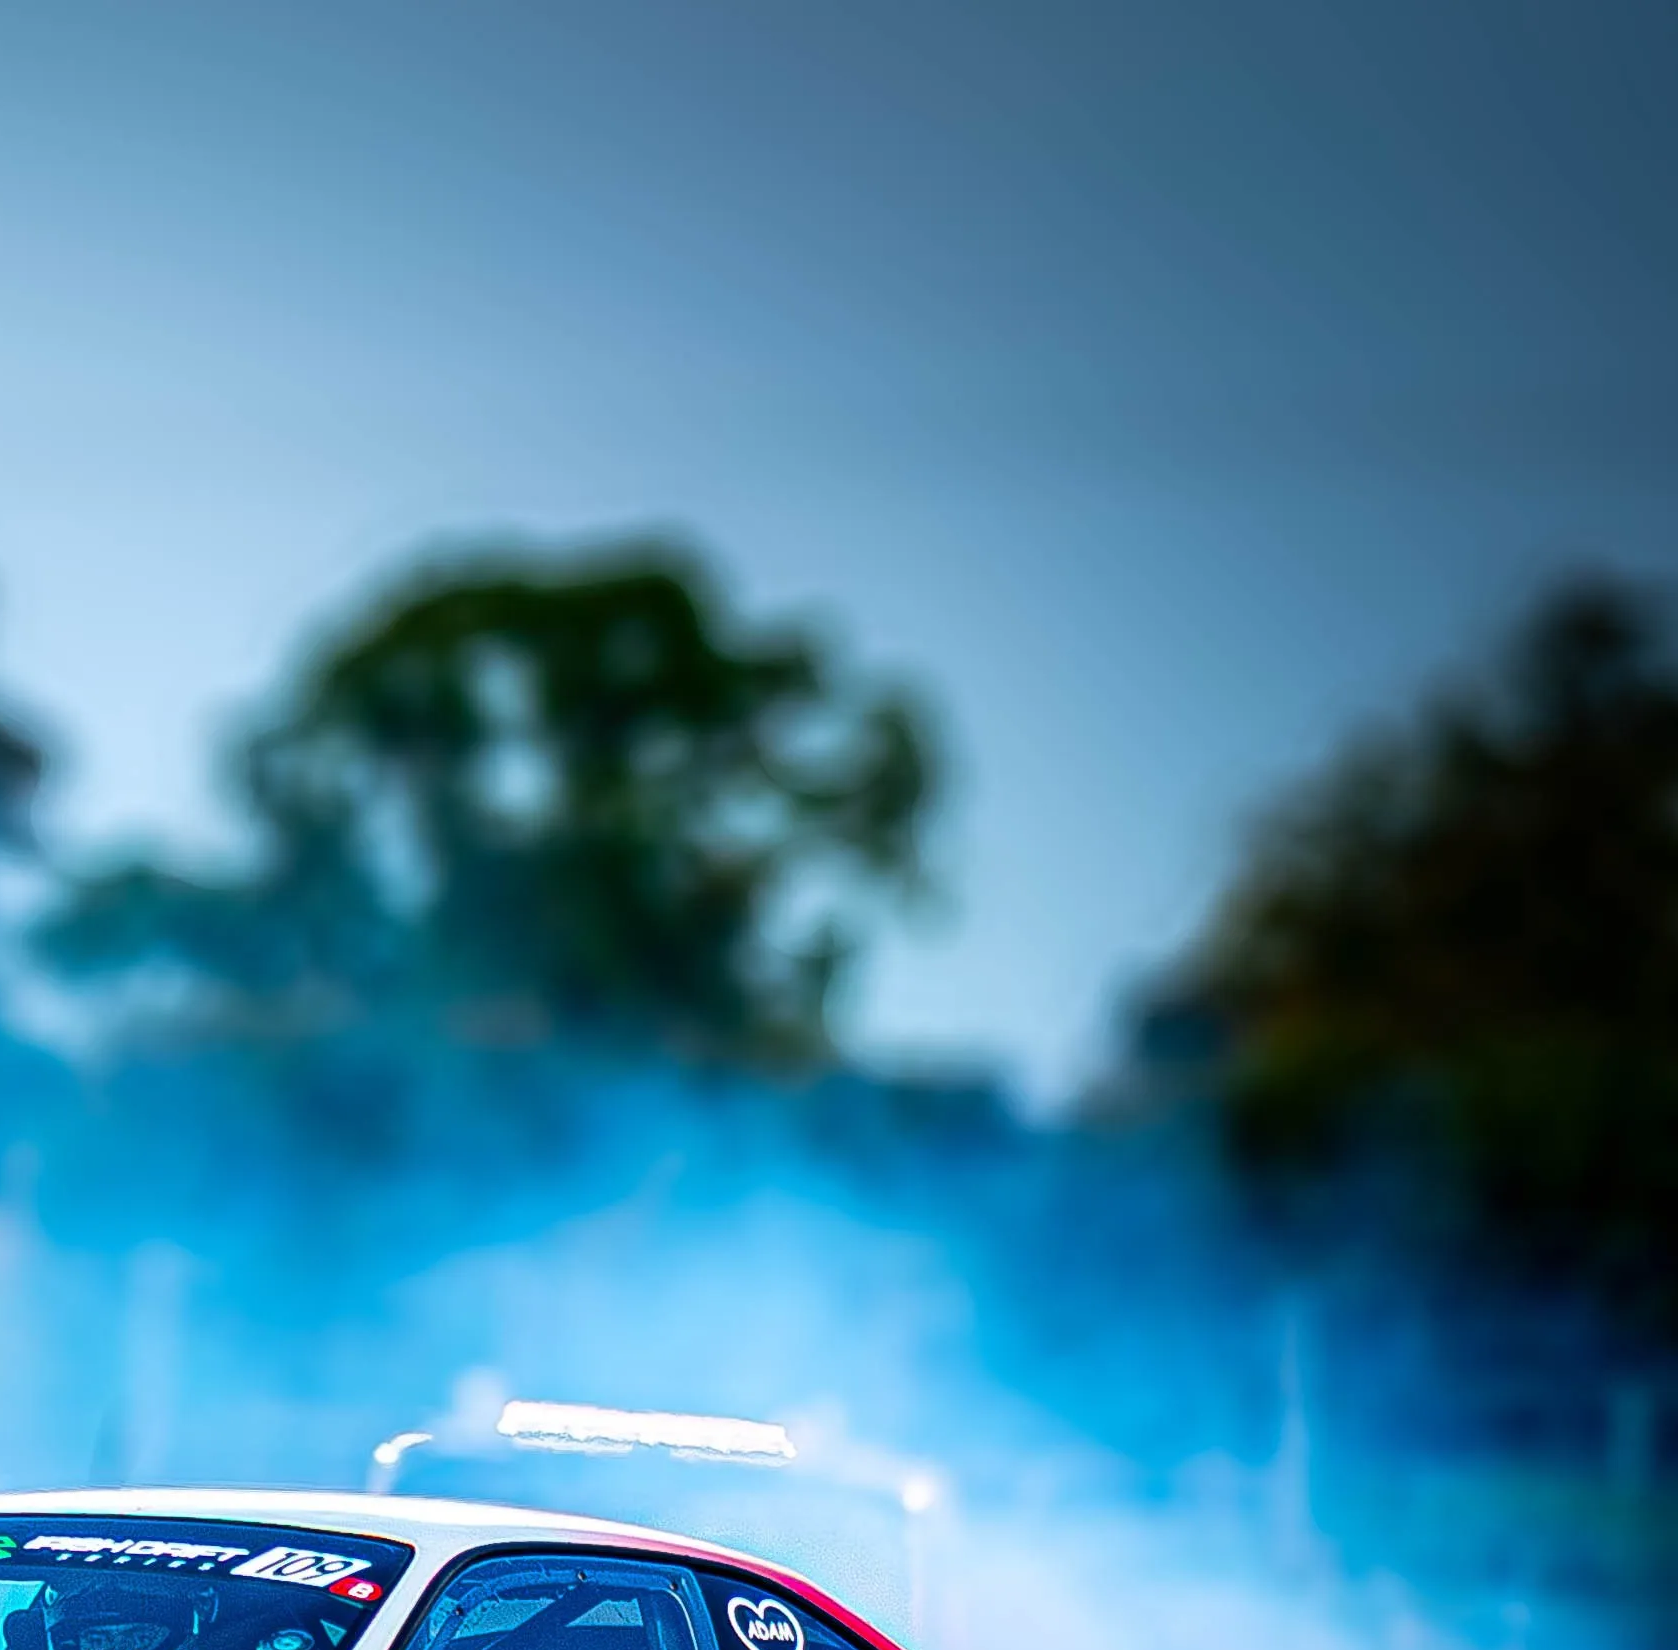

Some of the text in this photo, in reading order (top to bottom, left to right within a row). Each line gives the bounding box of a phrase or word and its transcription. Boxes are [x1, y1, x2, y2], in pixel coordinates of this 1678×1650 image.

[127, 1540, 249, 1562] DRIFT
[255, 1552, 354, 1580] 109
[347, 1582, 374, 1600] B
[748, 1620, 795, 1642] ADAM
